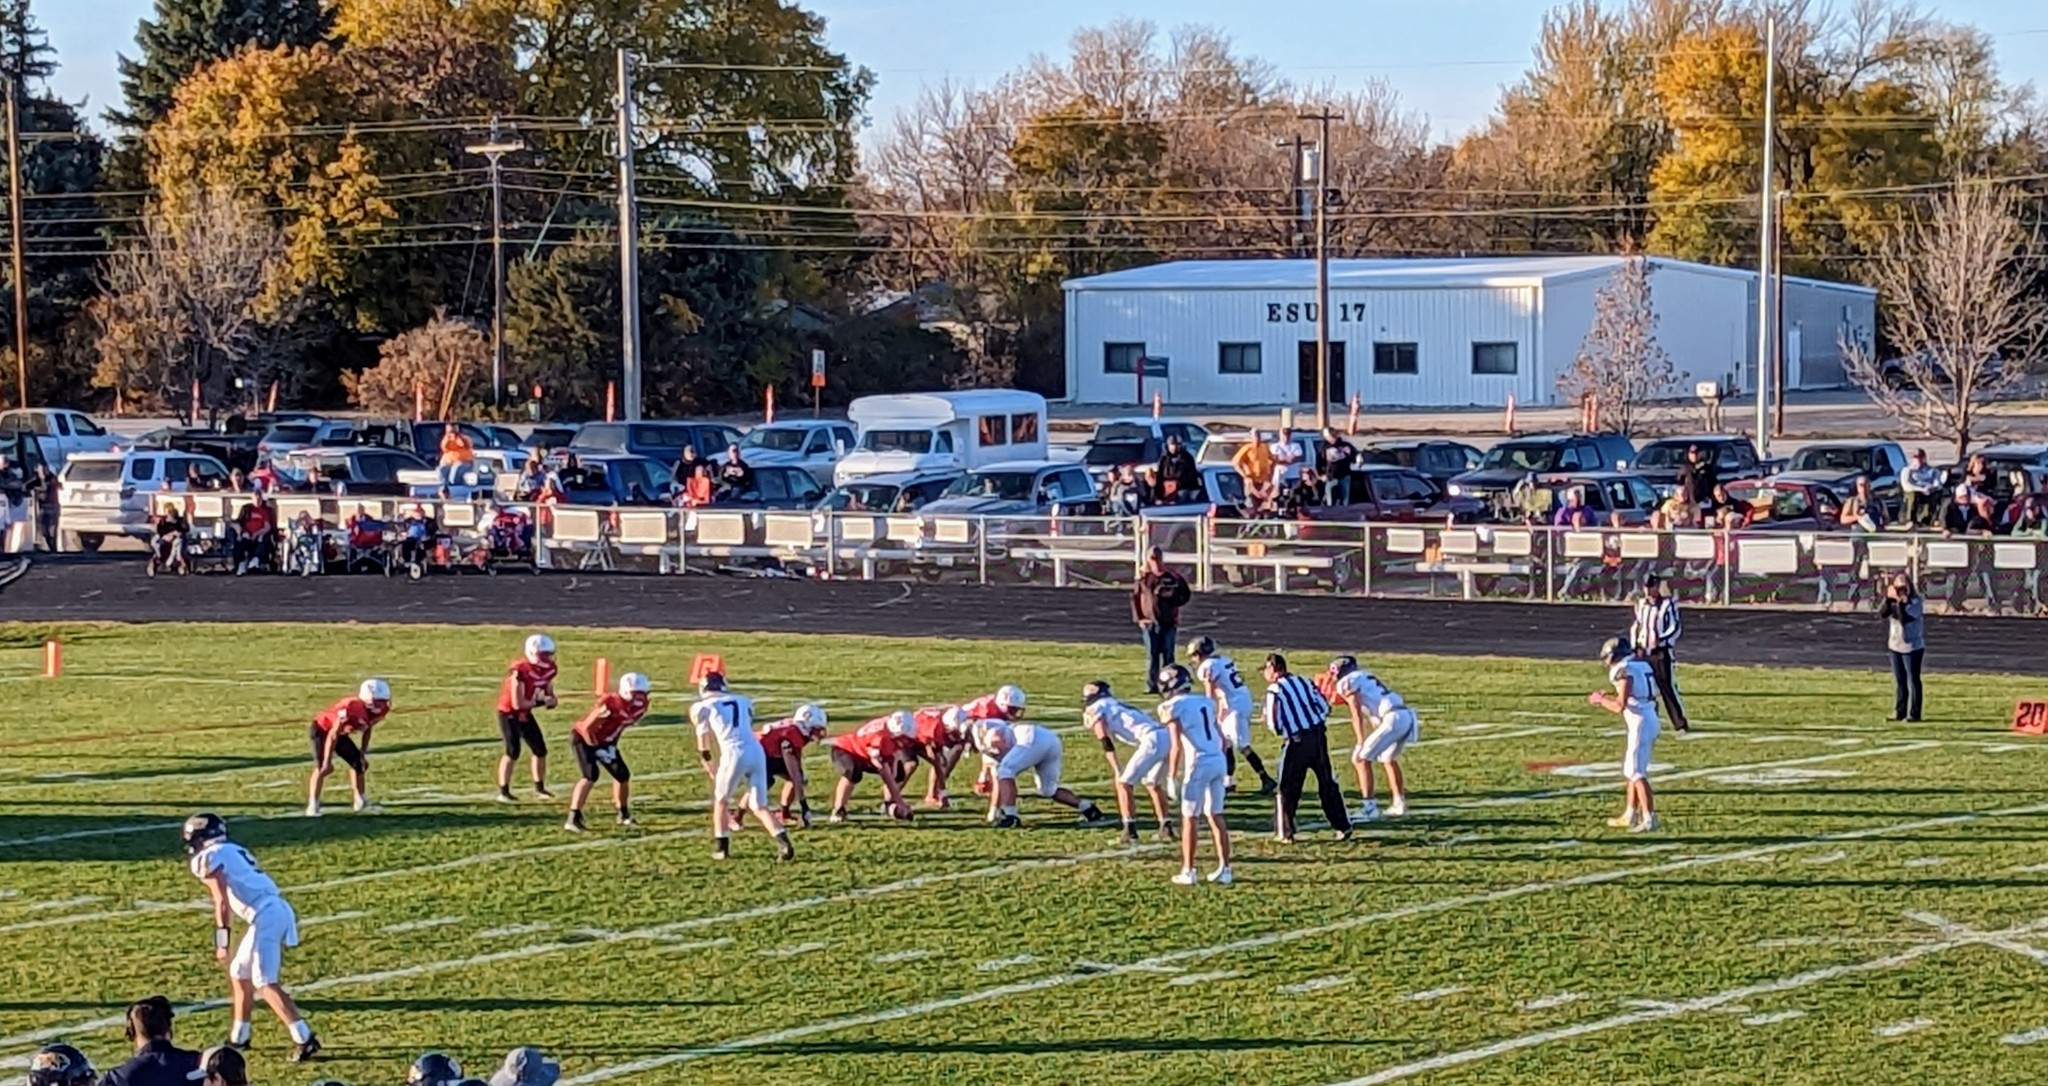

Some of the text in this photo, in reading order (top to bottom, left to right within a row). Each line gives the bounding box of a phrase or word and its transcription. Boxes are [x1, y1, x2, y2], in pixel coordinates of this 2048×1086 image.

[1267, 303, 1366, 323] ESU 17
[722, 700, 739, 728] 7
[1199, 706, 1213, 741] 1
[2016, 702, 2045, 728] 20
